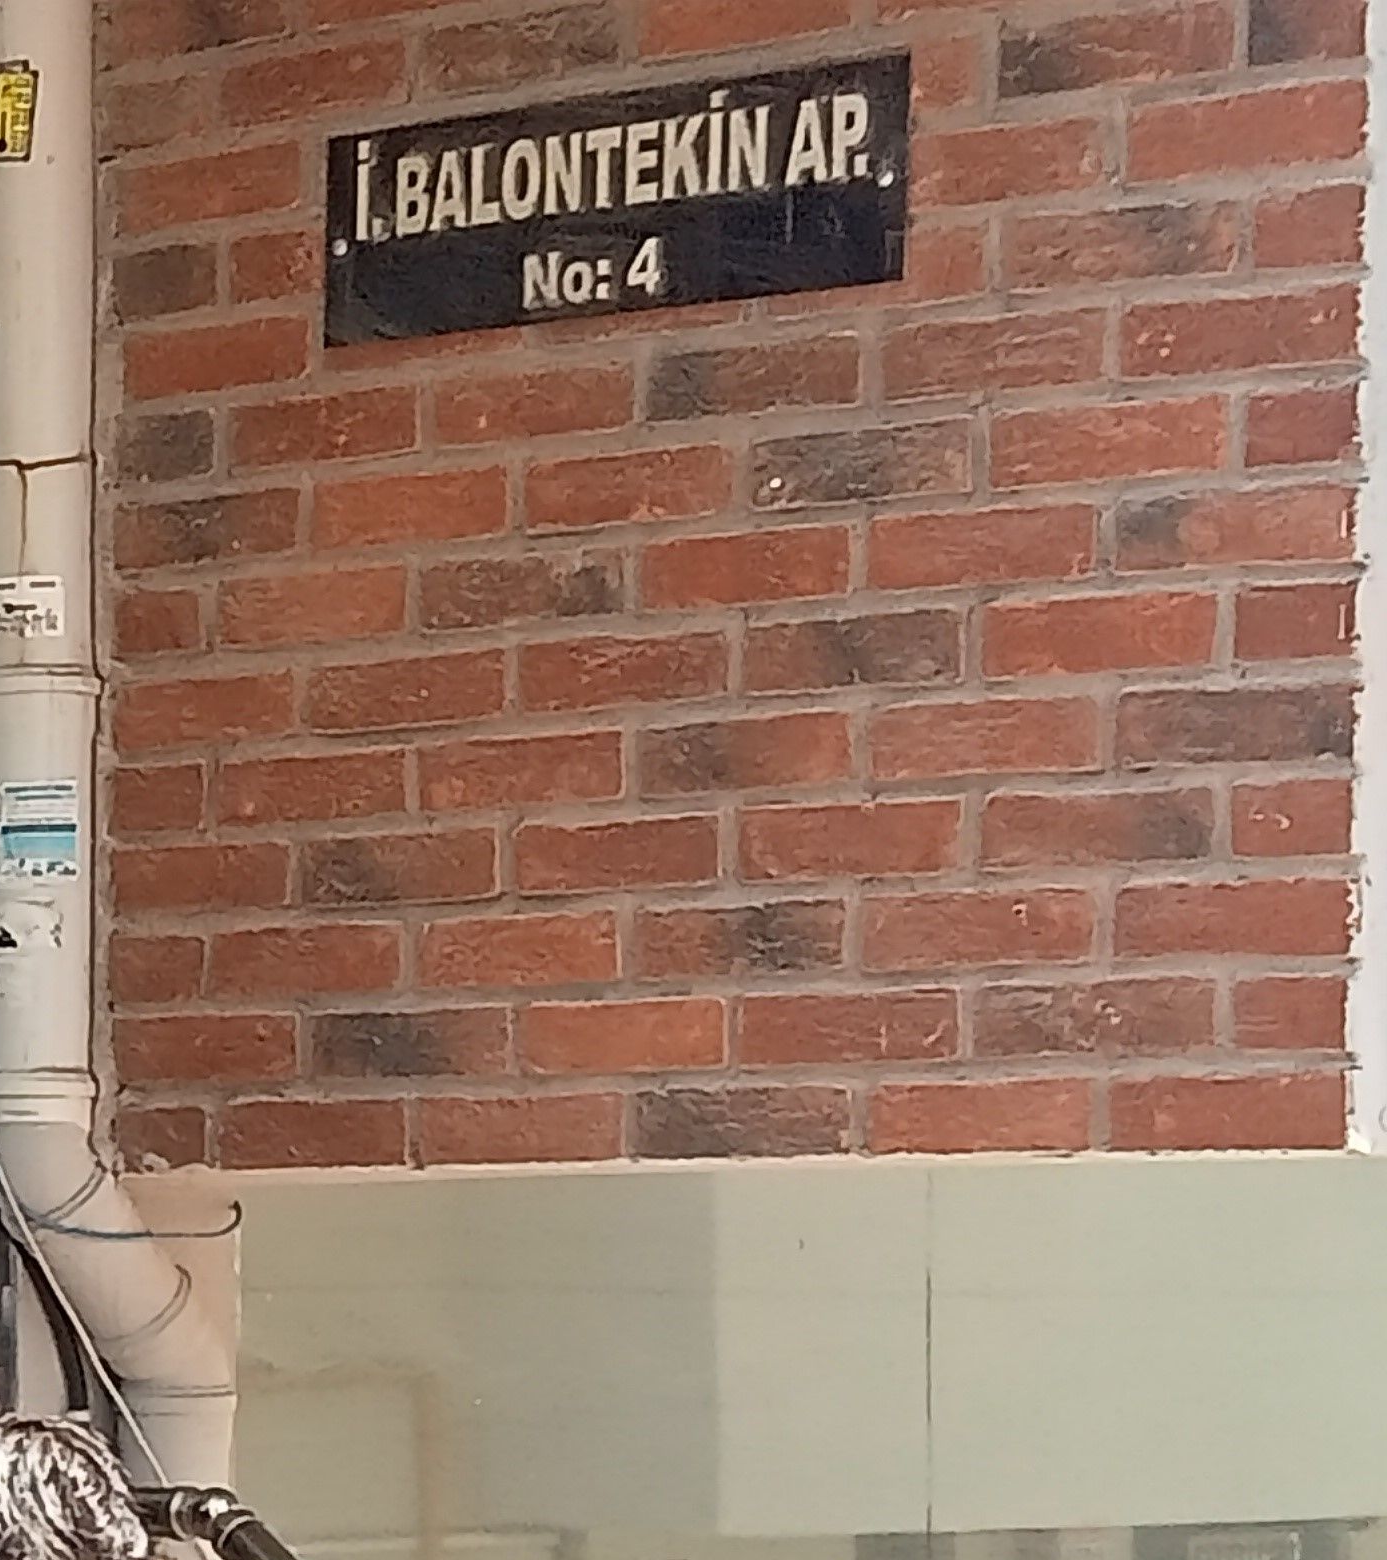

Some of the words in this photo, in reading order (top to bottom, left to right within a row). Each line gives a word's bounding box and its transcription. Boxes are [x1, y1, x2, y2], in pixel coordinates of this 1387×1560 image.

[784, 92, 871, 186] AP.
[523, 250, 614, 311] No:
[627, 235, 664, 294] 4
